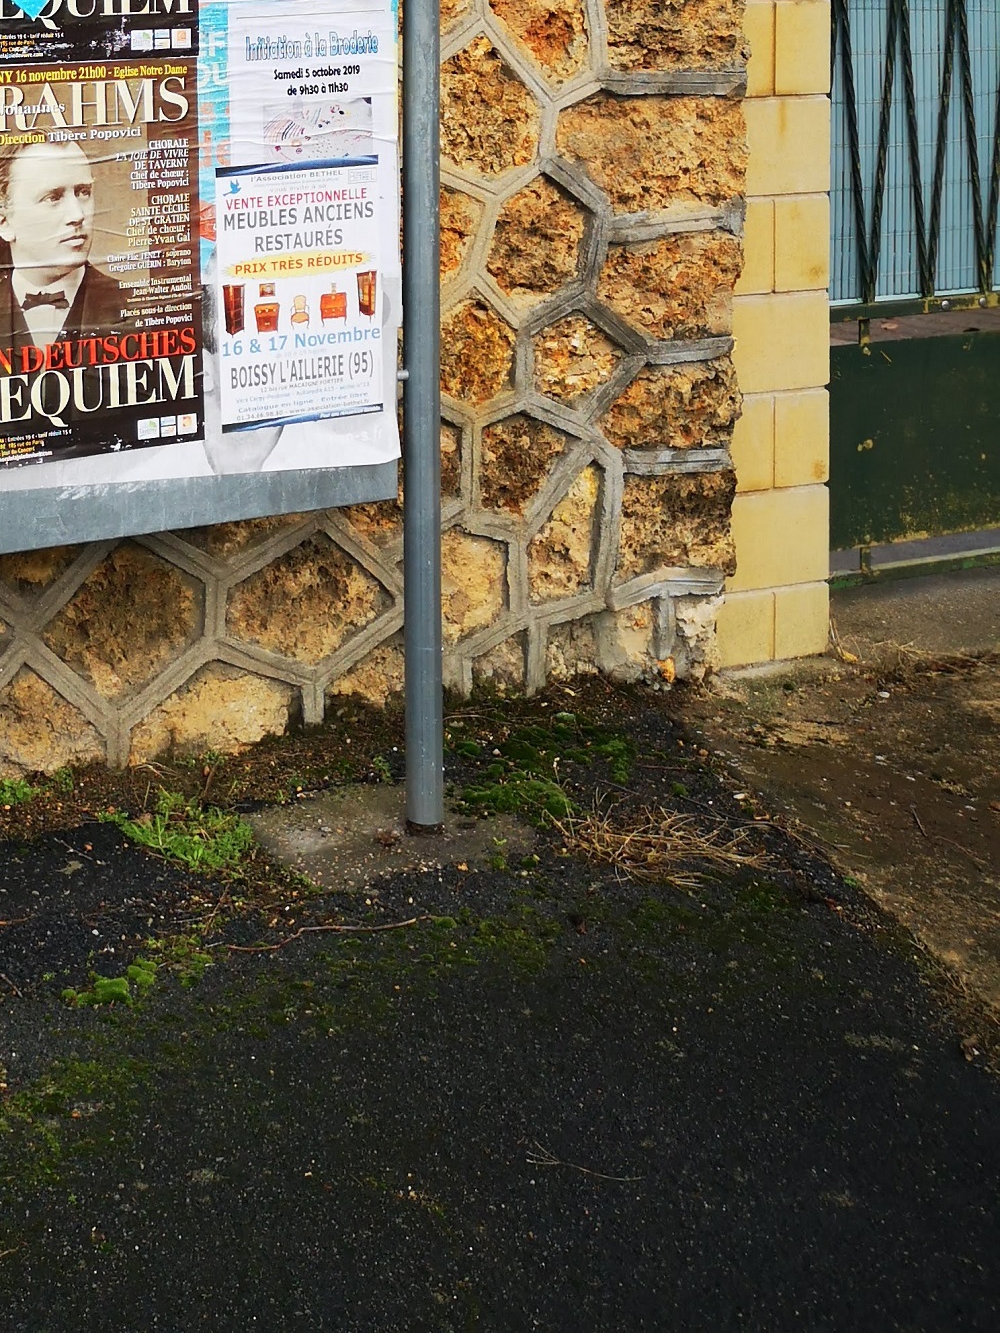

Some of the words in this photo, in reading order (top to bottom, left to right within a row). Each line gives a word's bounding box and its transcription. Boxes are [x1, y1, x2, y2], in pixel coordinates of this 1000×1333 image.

[245, 35, 301, 62] Initiation
[304, 32, 313, 58] à
[314, 32, 327, 57] la
[329, 30, 379, 56] Broderie
[15, 70, 27, 83] 16
[28, 68, 77, 83] novembre
[78, 66, 106, 80] 21h00
[113, 65, 139, 79] Eglise
[140, 65, 163, 76] Notre
[164, 64, 188, 76] Dame
[274, 67, 304, 80] Samedi
[305, 68, 311, 78] 5
[312, 66, 341, 78] octobre
[343, 64, 361, 75] 2019
[287, 85, 298, 96] de
[300, 85, 319, 95] 9h30
[321, 83, 327, 94] à
[328, 82, 349, 93] 11h30
[0, 102, 65, 117] Johannes
[48, 130, 87, 142] Tibère
[89, 127, 142, 141] Popovici
[149, 138, 190, 149] CHORALE
[116, 153, 128, 161] LA
[129, 151, 149, 162] JOIE
[150, 149, 162, 159] DE
[163, 148, 190, 158] VIVRE
[134, 160, 147, 170] DE
[148, 158, 189, 170] TAVERNY
[130, 170, 149, 180] Chef
[150, 169, 160, 179] de
[251, 172, 308, 183] l'Association
[310, 169, 343, 178] BETHEL
[131, 180, 156, 190] Tibère
[157, 177, 189, 189] Popovici
[151, 193, 190, 205] CHORALE
[226, 196, 263, 210] VENTE
[268, 187, 368, 207] EXCEPTIONNELLE
[131, 206, 161, 217] SAINTE
[224, 207, 297, 231] MEUBLES
[303, 201, 375, 224] ANCIENS
[129, 217, 142, 227] DE
[154, 213, 190, 225] GRATIEN
[126, 226, 145, 237] Chef
[148, 225, 158, 235] de
[255, 224, 343, 253] RESTAURÉS
[235, 263, 267, 275] PRIX
[271, 255, 304, 271] TRÈS
[307, 251, 363, 267] RÉDUITS
[120, 308, 141, 318] Placés
[164, 303, 192, 313] direction
[135, 318, 144, 328] de
[144, 317, 165, 326] Tibère
[165, 313, 193, 325] Popovici
[222, 340, 243, 357] 16
[249, 338, 262, 353] &
[269, 335, 288, 352] 17
[294, 326, 381, 349] Novembre
[21, 327, 197, 373] DEUTSCHES
[231, 363, 277, 390] BOISSY
[279, 354, 345, 384] L'AILLERIE
[347, 349, 374, 380] (95)
